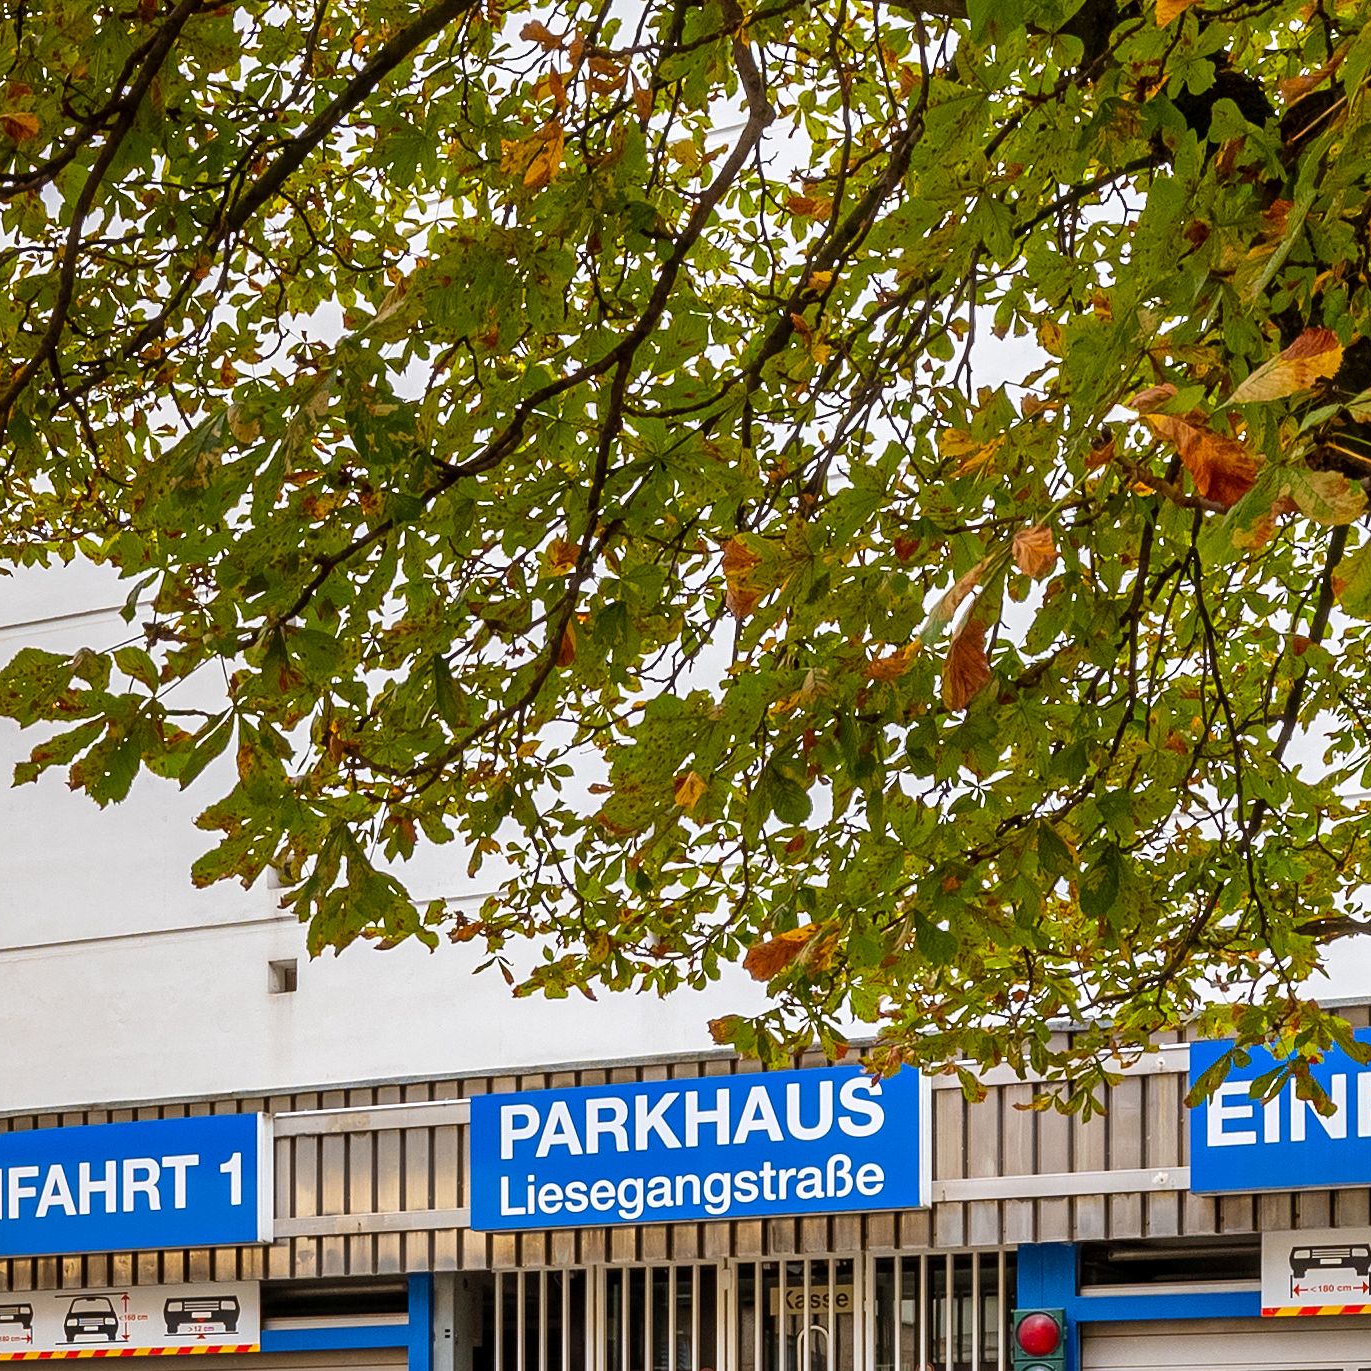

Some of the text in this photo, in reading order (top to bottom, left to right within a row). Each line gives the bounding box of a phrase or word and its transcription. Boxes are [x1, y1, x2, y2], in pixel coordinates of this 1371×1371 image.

[500, 1077, 884, 1160] PARKHAUS
[219, 1152, 242, 1206] 1
[500, 1154, 885, 1220] Liesegangstraße
[1336, 1284, 1352, 1292] cm
